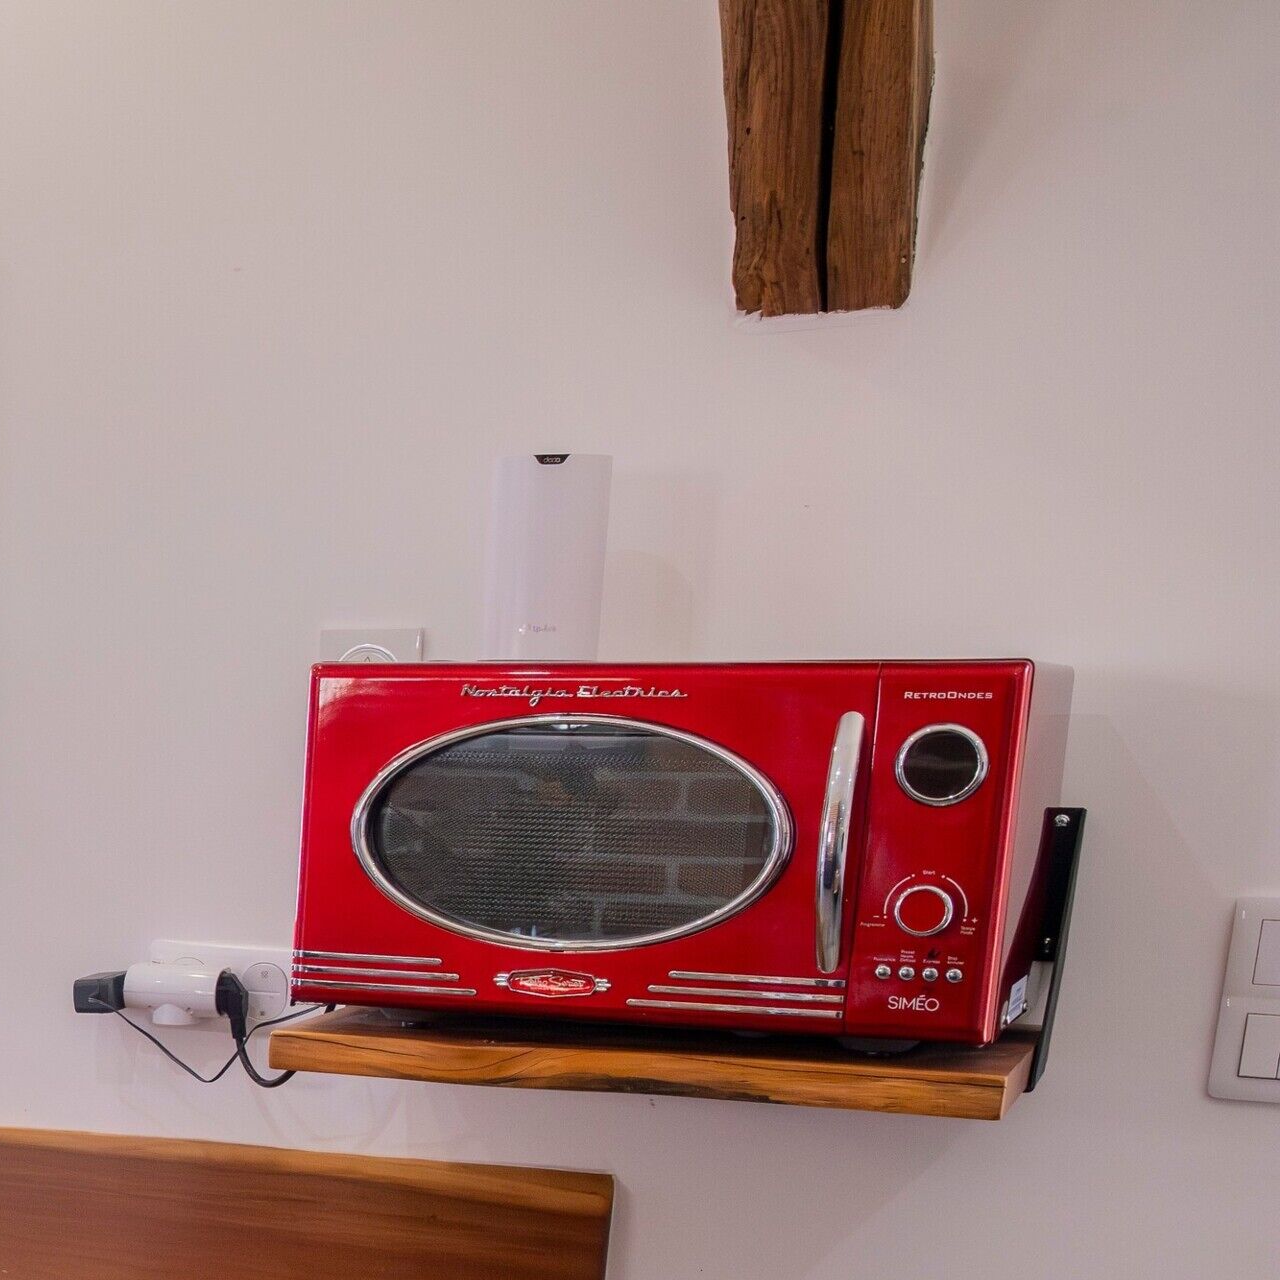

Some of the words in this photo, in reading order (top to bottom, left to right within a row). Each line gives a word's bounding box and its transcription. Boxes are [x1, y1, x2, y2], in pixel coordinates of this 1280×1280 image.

[461, 684, 573, 706] Nostalgia
[576, 685, 688, 699] Electrics
[887, 994, 940, 1012] SIMÉO
